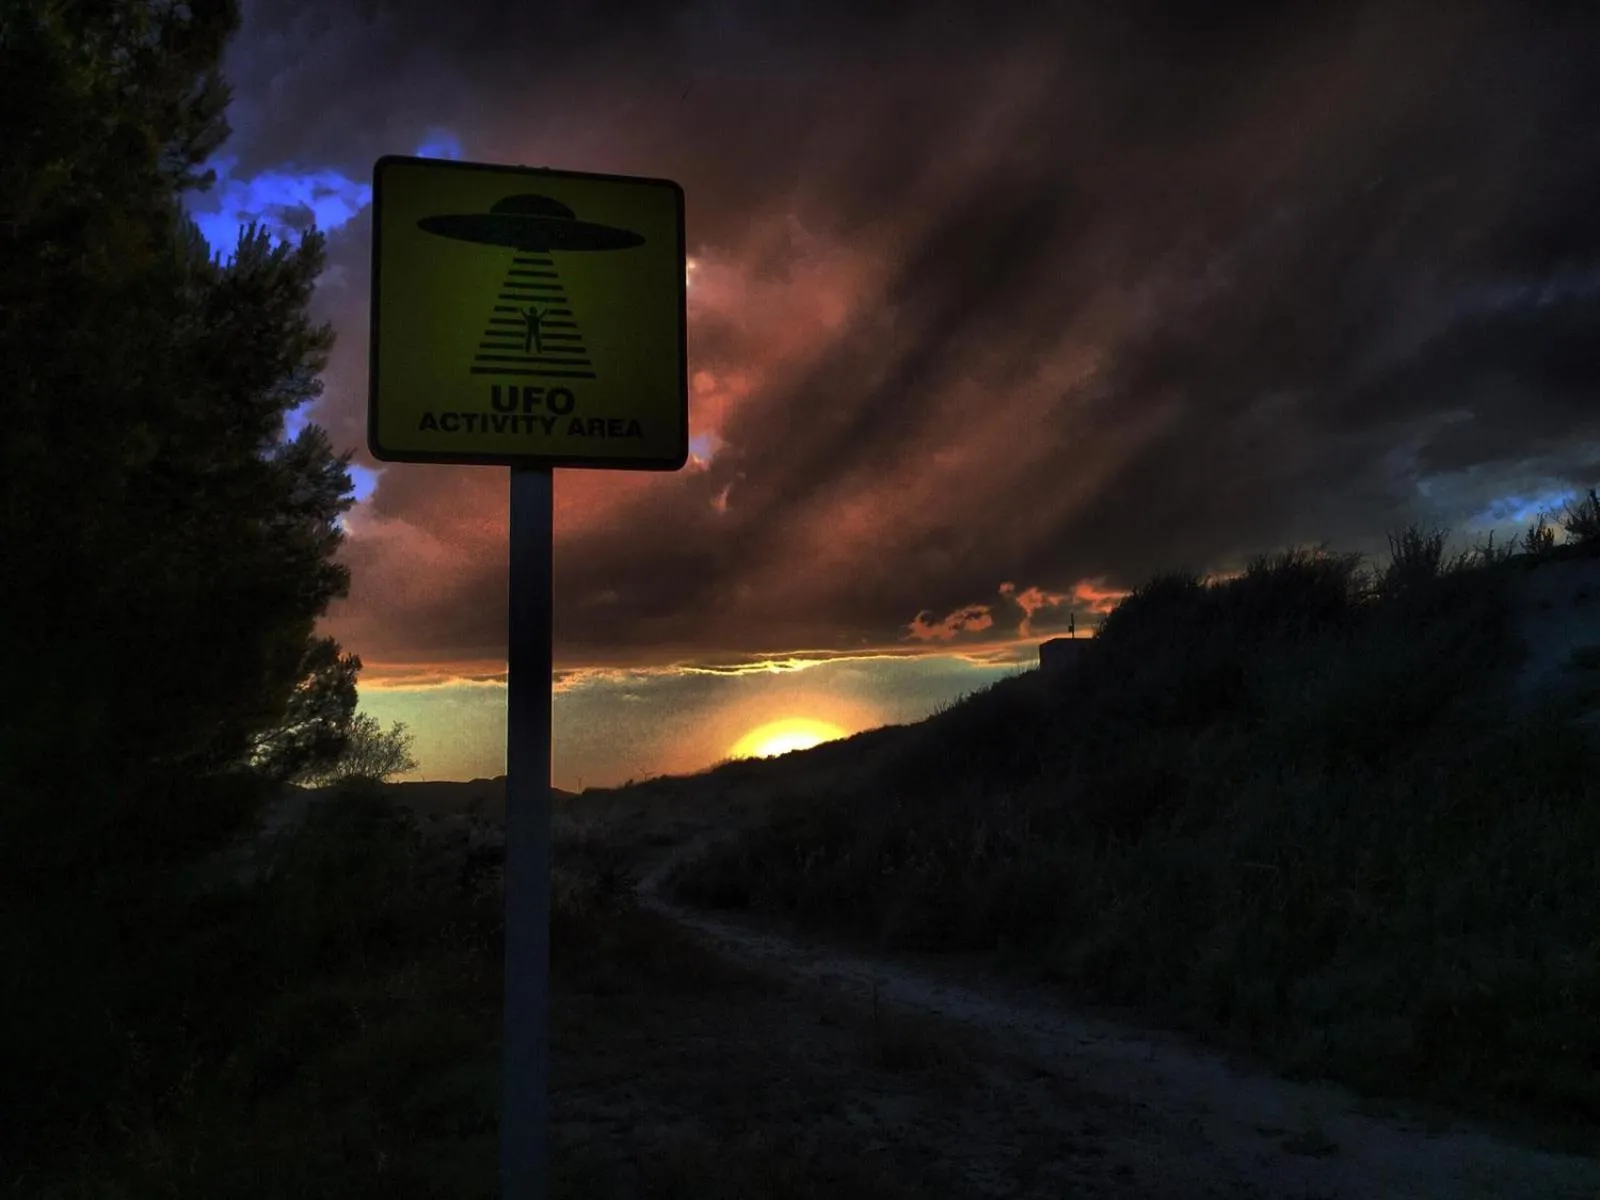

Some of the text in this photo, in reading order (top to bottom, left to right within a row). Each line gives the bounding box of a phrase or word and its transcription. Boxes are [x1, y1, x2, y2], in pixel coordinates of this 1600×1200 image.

[491, 384, 575, 415] UFO
[419, 412, 643, 438] ACTIVITY AREA
